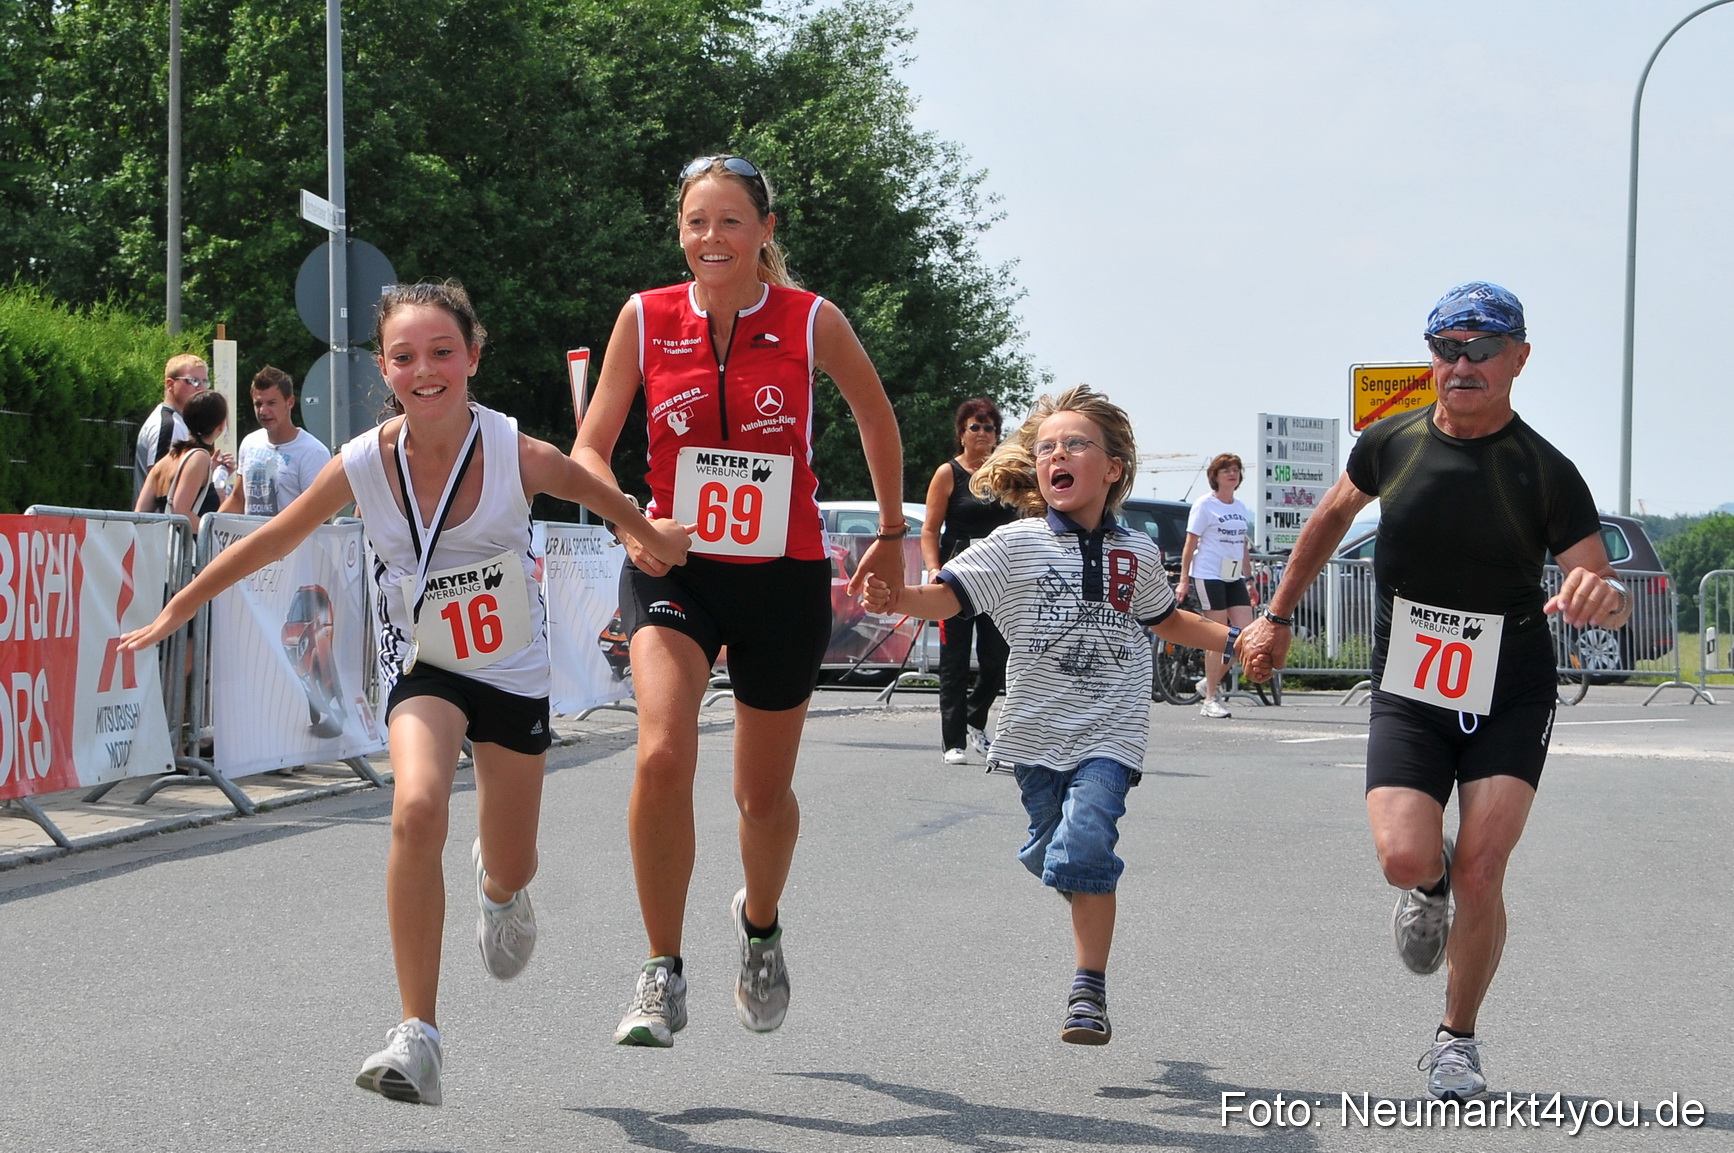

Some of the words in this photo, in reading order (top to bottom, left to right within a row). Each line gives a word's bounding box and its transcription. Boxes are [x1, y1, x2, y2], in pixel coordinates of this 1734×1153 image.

[680, 336, 702, 347] Altdorf
[663, 347, 693, 355] Triathlon
[1361, 375, 1432, 396] Sengenthal
[1370, 398, 1386, 406] am
[1391, 396, 1422, 408] Anger
[696, 452, 749, 470] MEYER
[696, 465, 749, 479] WERBUNG
[1274, 465, 1291, 483] SHB
[697, 481, 763, 545] 69
[1274, 512, 1300, 528] THULE
[1217, 527, 1237, 536] POWER
[1231, 560, 1238, 577] 7
[0, 530, 76, 641] BISHI
[424, 570, 480, 593] MEYER
[424, 583, 481, 601] WERBUNG
[648, 606, 687, 620] skinfit
[1410, 605, 1461, 627] MEYER
[440, 593, 504, 660] 16
[1409, 616, 1460, 636] WERBUNG
[1413, 633, 1473, 699] 70
[96, 702, 141, 734] MITSUBISHI
